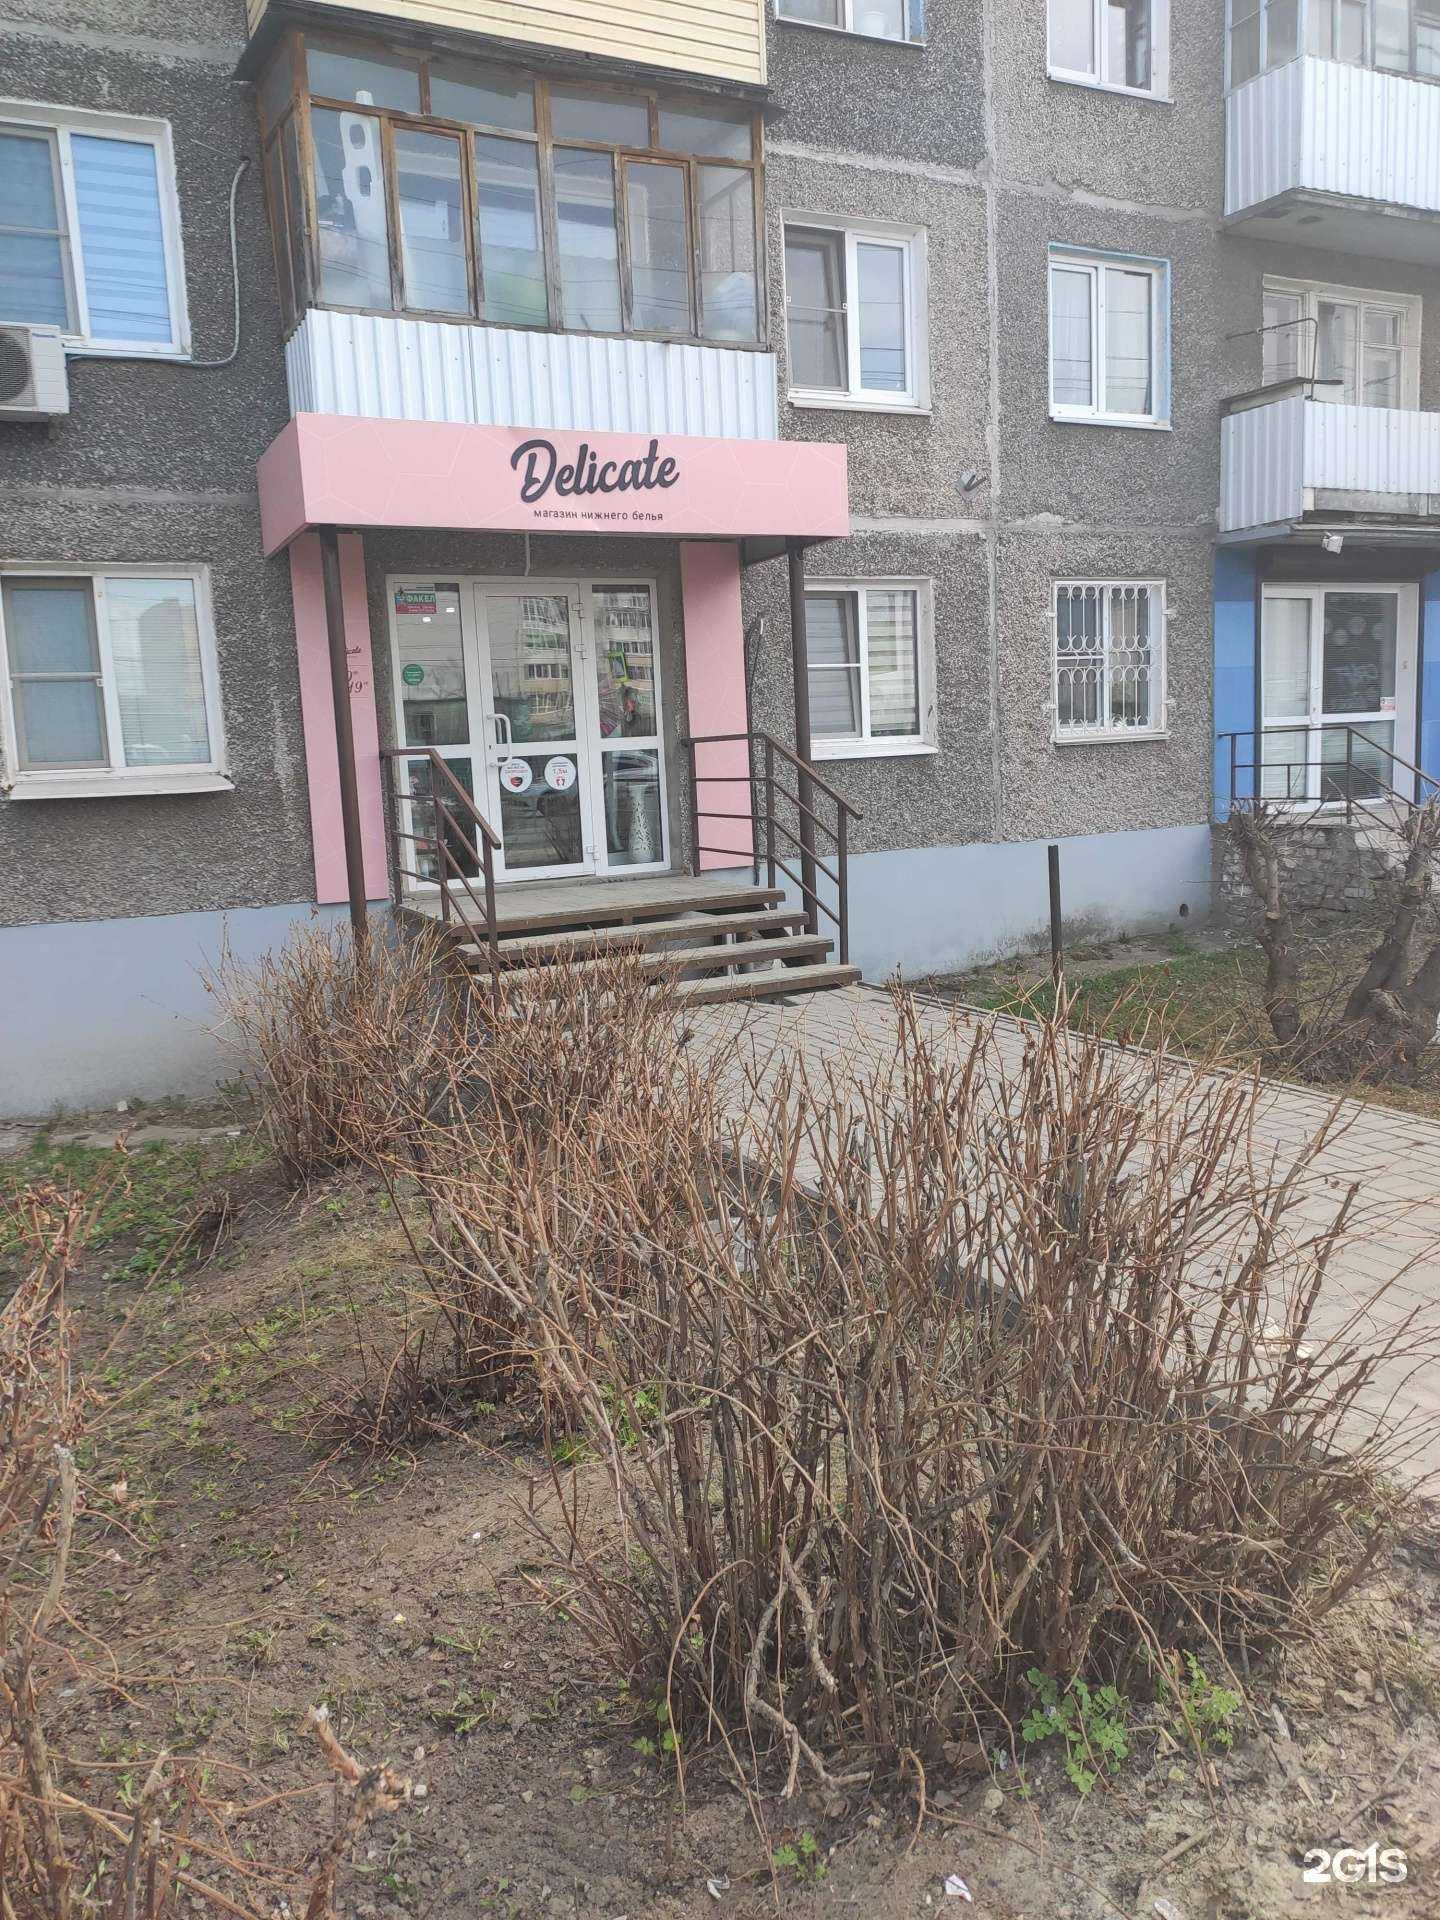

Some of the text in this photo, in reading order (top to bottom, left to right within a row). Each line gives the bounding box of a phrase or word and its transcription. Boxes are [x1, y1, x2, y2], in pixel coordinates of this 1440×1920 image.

[510, 439, 680, 503] Delicate
[534, 509, 664, 521] магазин нижнего белья
